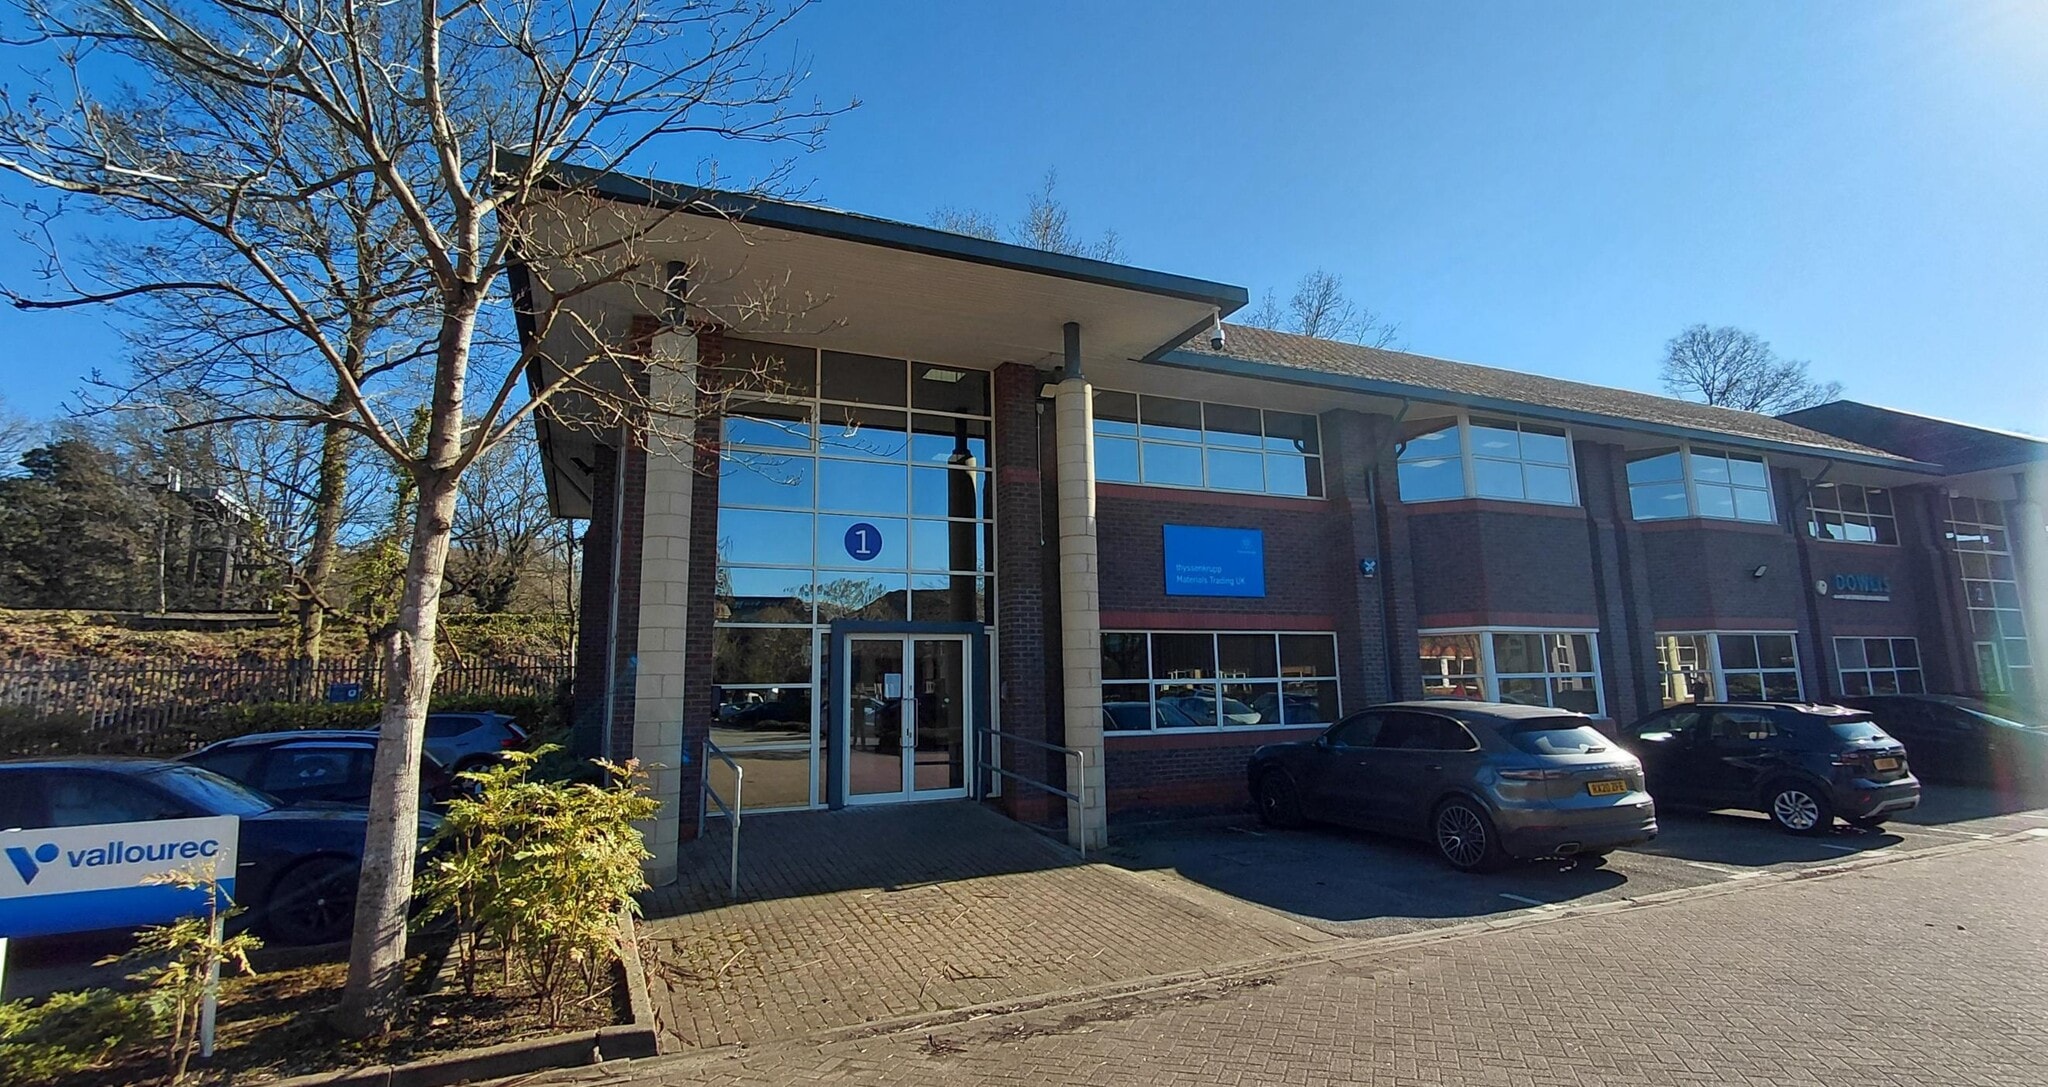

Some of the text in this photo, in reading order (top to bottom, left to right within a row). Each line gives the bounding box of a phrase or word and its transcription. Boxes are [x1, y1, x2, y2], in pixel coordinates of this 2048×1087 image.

[855, 529, 871, 554] 1
[1176, 575, 1246, 587] Materials Trading UK
[67, 838, 219, 869] vallourec
